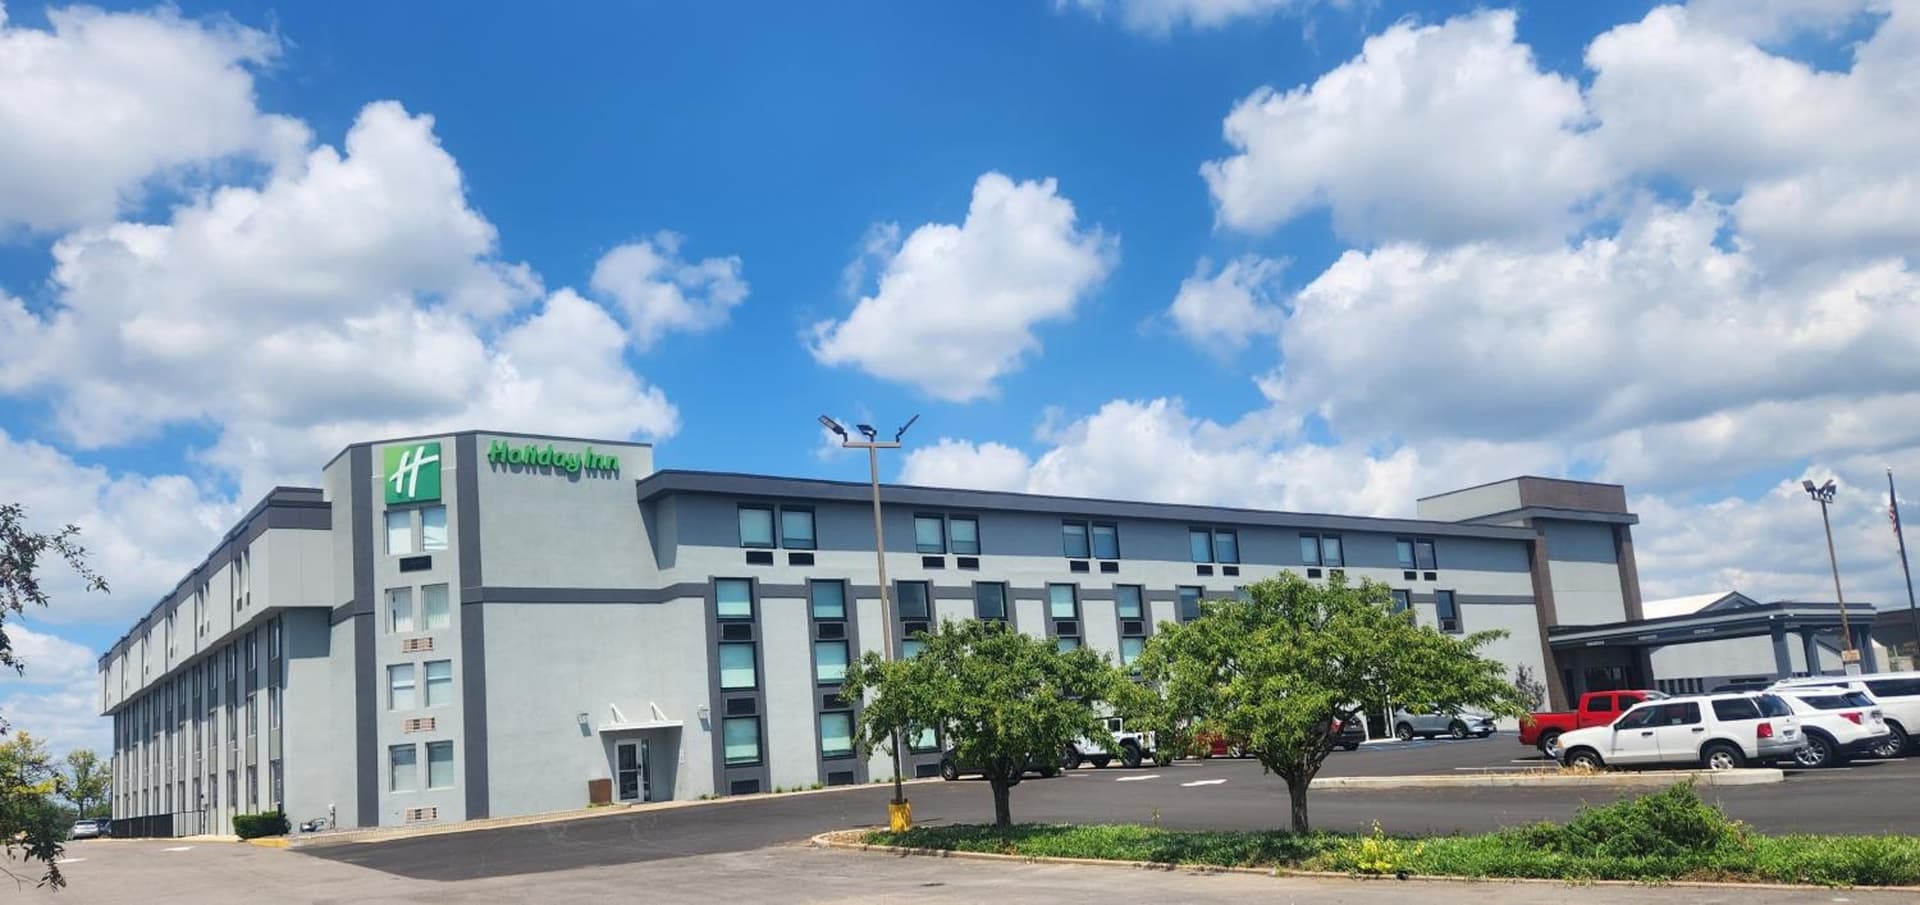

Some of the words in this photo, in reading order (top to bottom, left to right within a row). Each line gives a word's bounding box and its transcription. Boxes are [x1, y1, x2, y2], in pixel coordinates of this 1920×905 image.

[389, 446, 439, 498] H
[488, 439, 582, 472] Holiday
[584, 446, 620, 471] Inn
